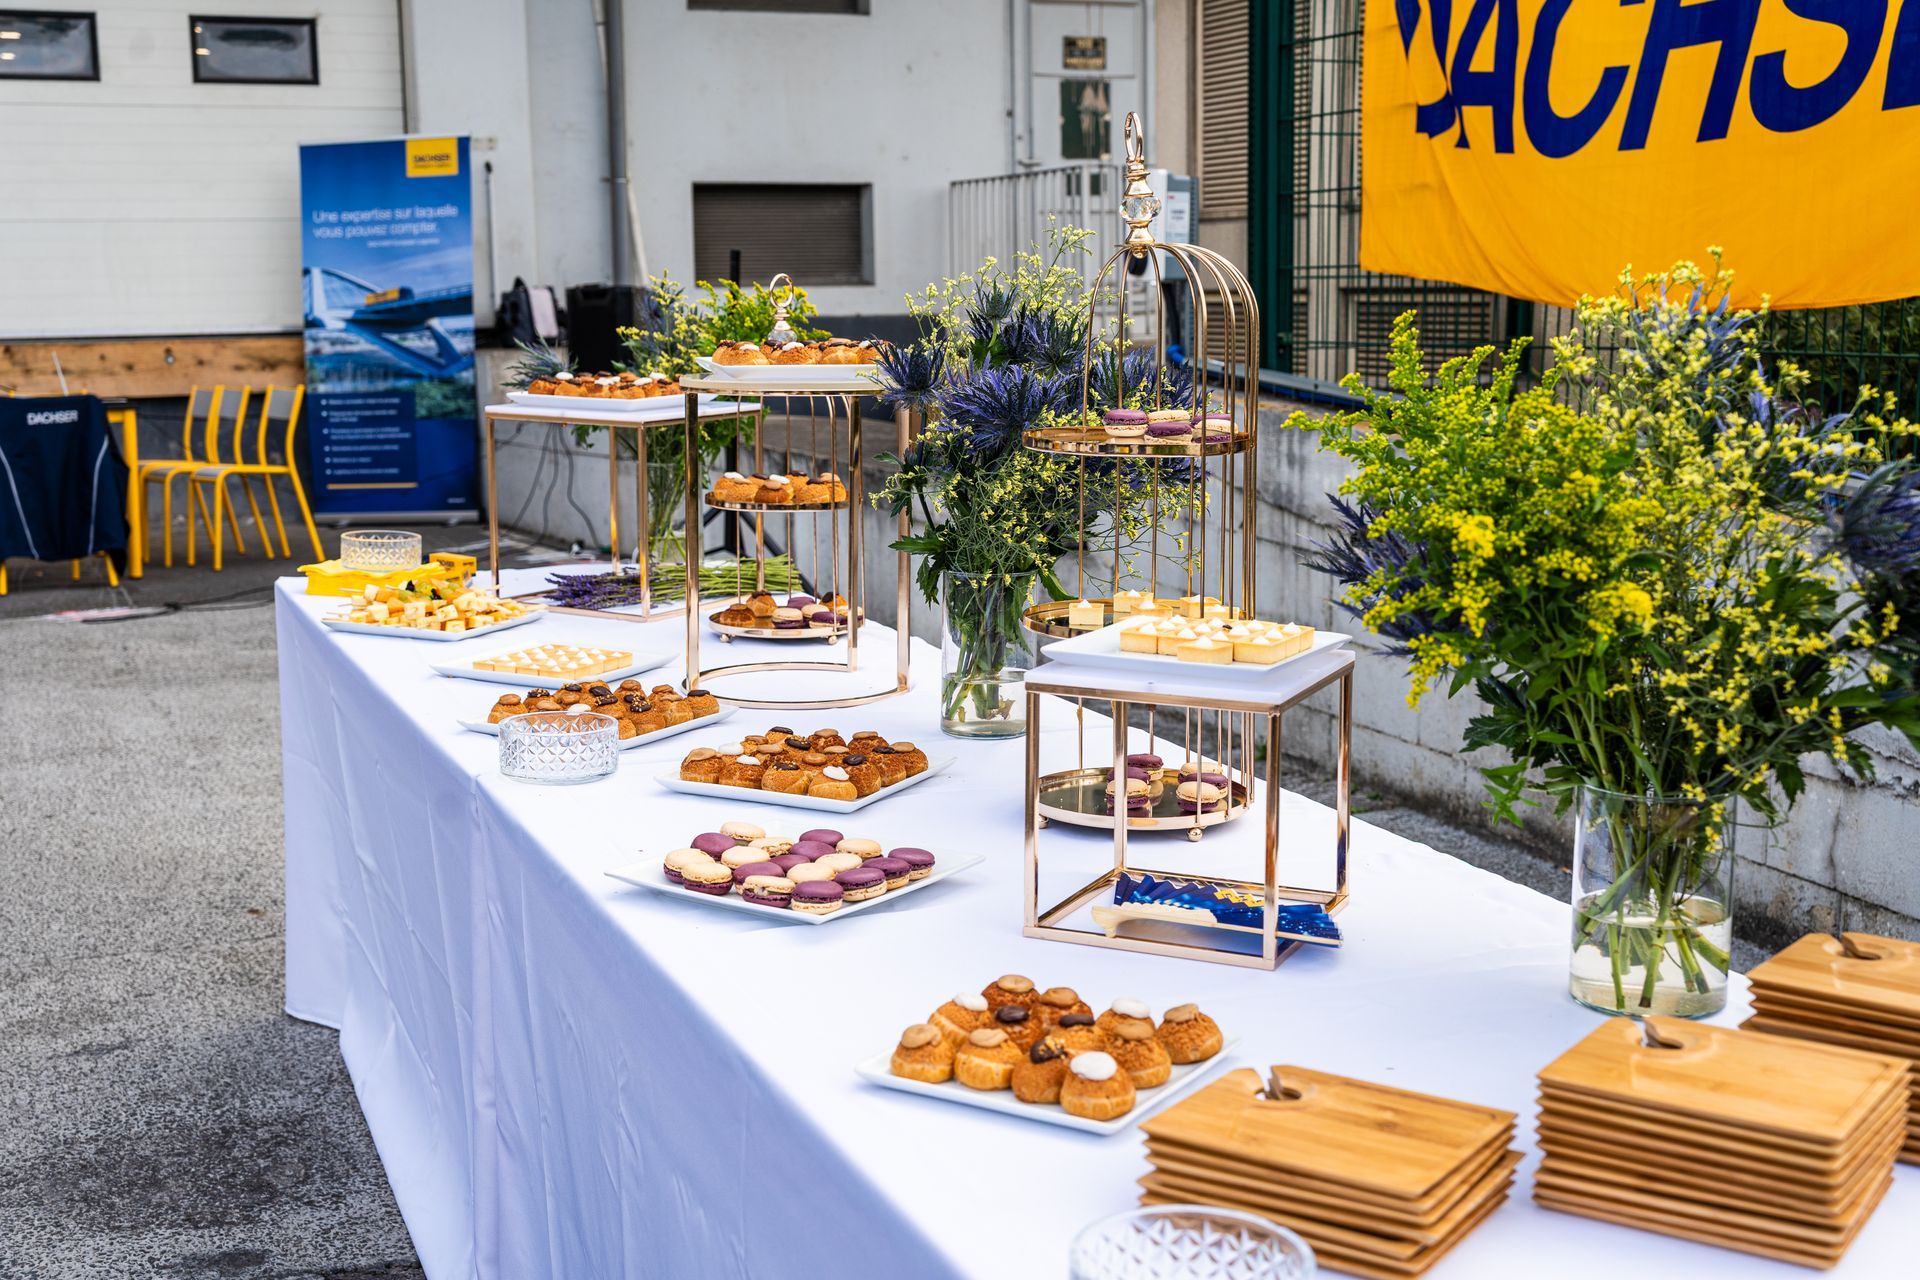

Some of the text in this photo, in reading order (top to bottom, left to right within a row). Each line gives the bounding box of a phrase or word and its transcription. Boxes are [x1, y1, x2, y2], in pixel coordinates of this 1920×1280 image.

[312, 205, 459, 223] Une expertise sur laquelle
[313, 226, 343, 238] vous
[345, 224, 387, 239] pouvez
[26, 410, 79, 425] DACHSER
